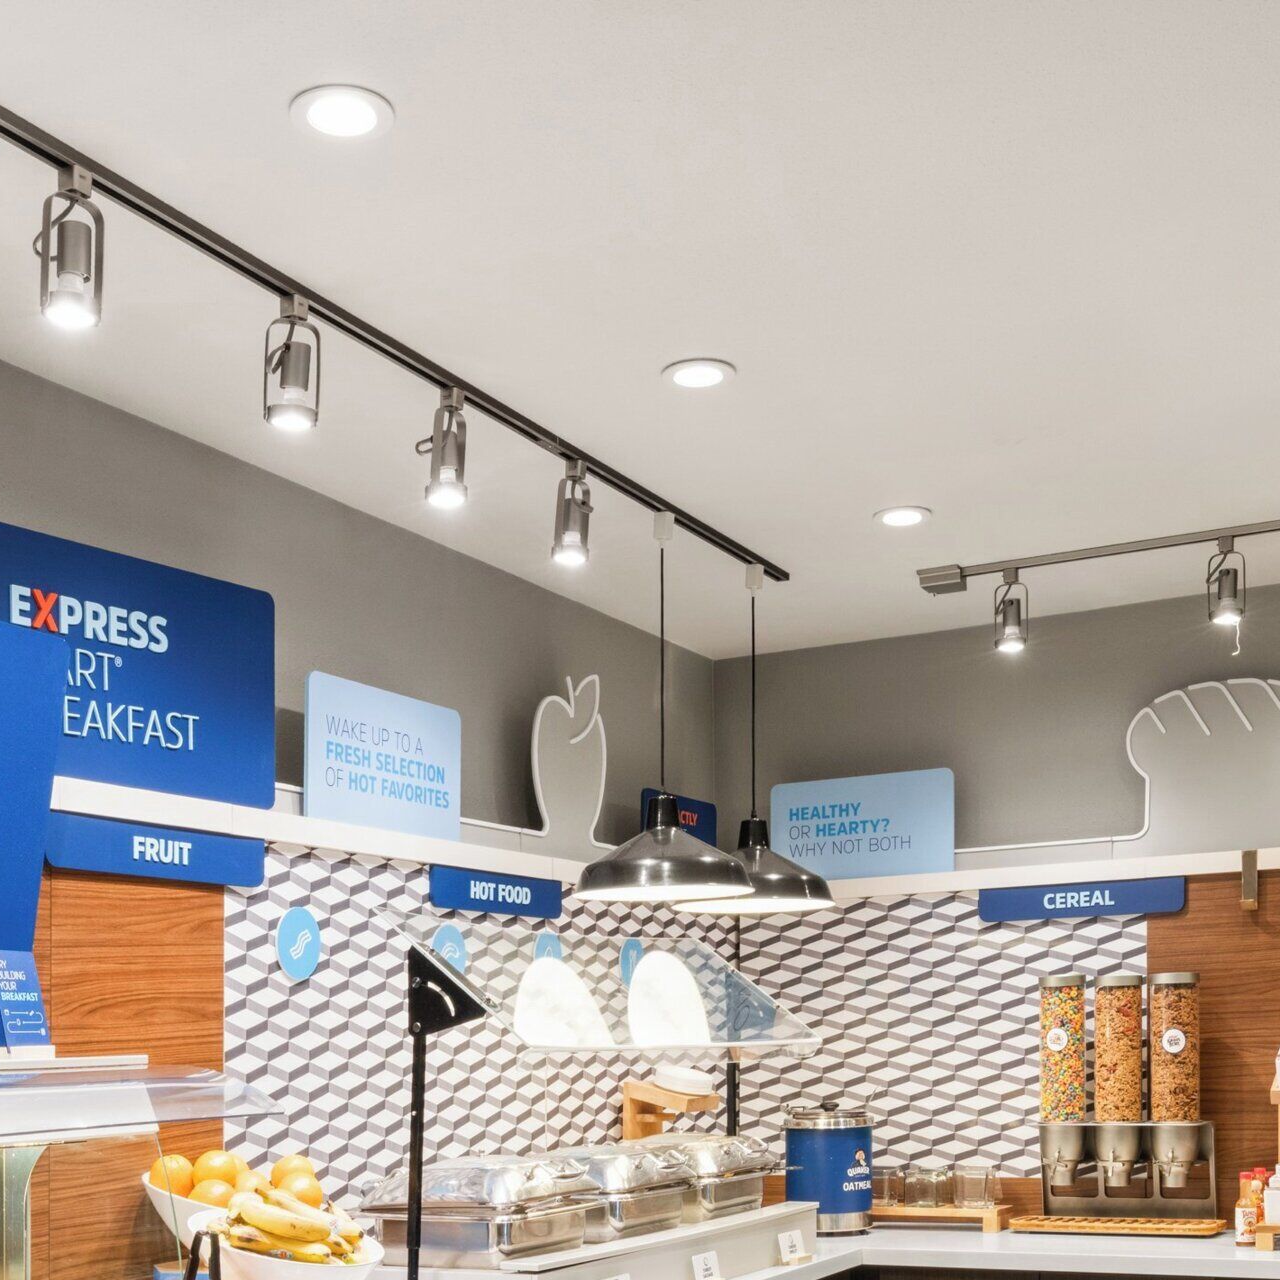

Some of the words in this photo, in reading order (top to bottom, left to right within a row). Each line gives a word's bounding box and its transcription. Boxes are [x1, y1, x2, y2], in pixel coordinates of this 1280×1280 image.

[10, 583, 169, 654] EXPRESS
[325, 713, 367, 743] WAKE
[371, 725, 390, 747] UP
[394, 731, 411, 753] TO
[414, 737, 424, 756] A
[325, 740, 372, 768] FRESH
[375, 752, 445, 785] SELECTION
[325, 766, 344, 788] OF
[348, 770, 377, 795] HOT
[381, 777, 450, 809] FAVORITES
[789, 801, 861, 822] HEALTHY
[789, 825, 811, 840] OR
[815, 818, 890, 838] HEARTY?
[132, 834, 192, 867] FRUIT
[789, 841, 827, 858] WHY
[832, 838, 864, 855] NOT
[869, 834, 912, 852] BOTH
[470, 880, 495, 902] HOT
[498, 882, 531, 906] FOOD
[1042, 888, 1116, 911] CEREAL
[0, 991, 39, 1002] BREAKFAST
